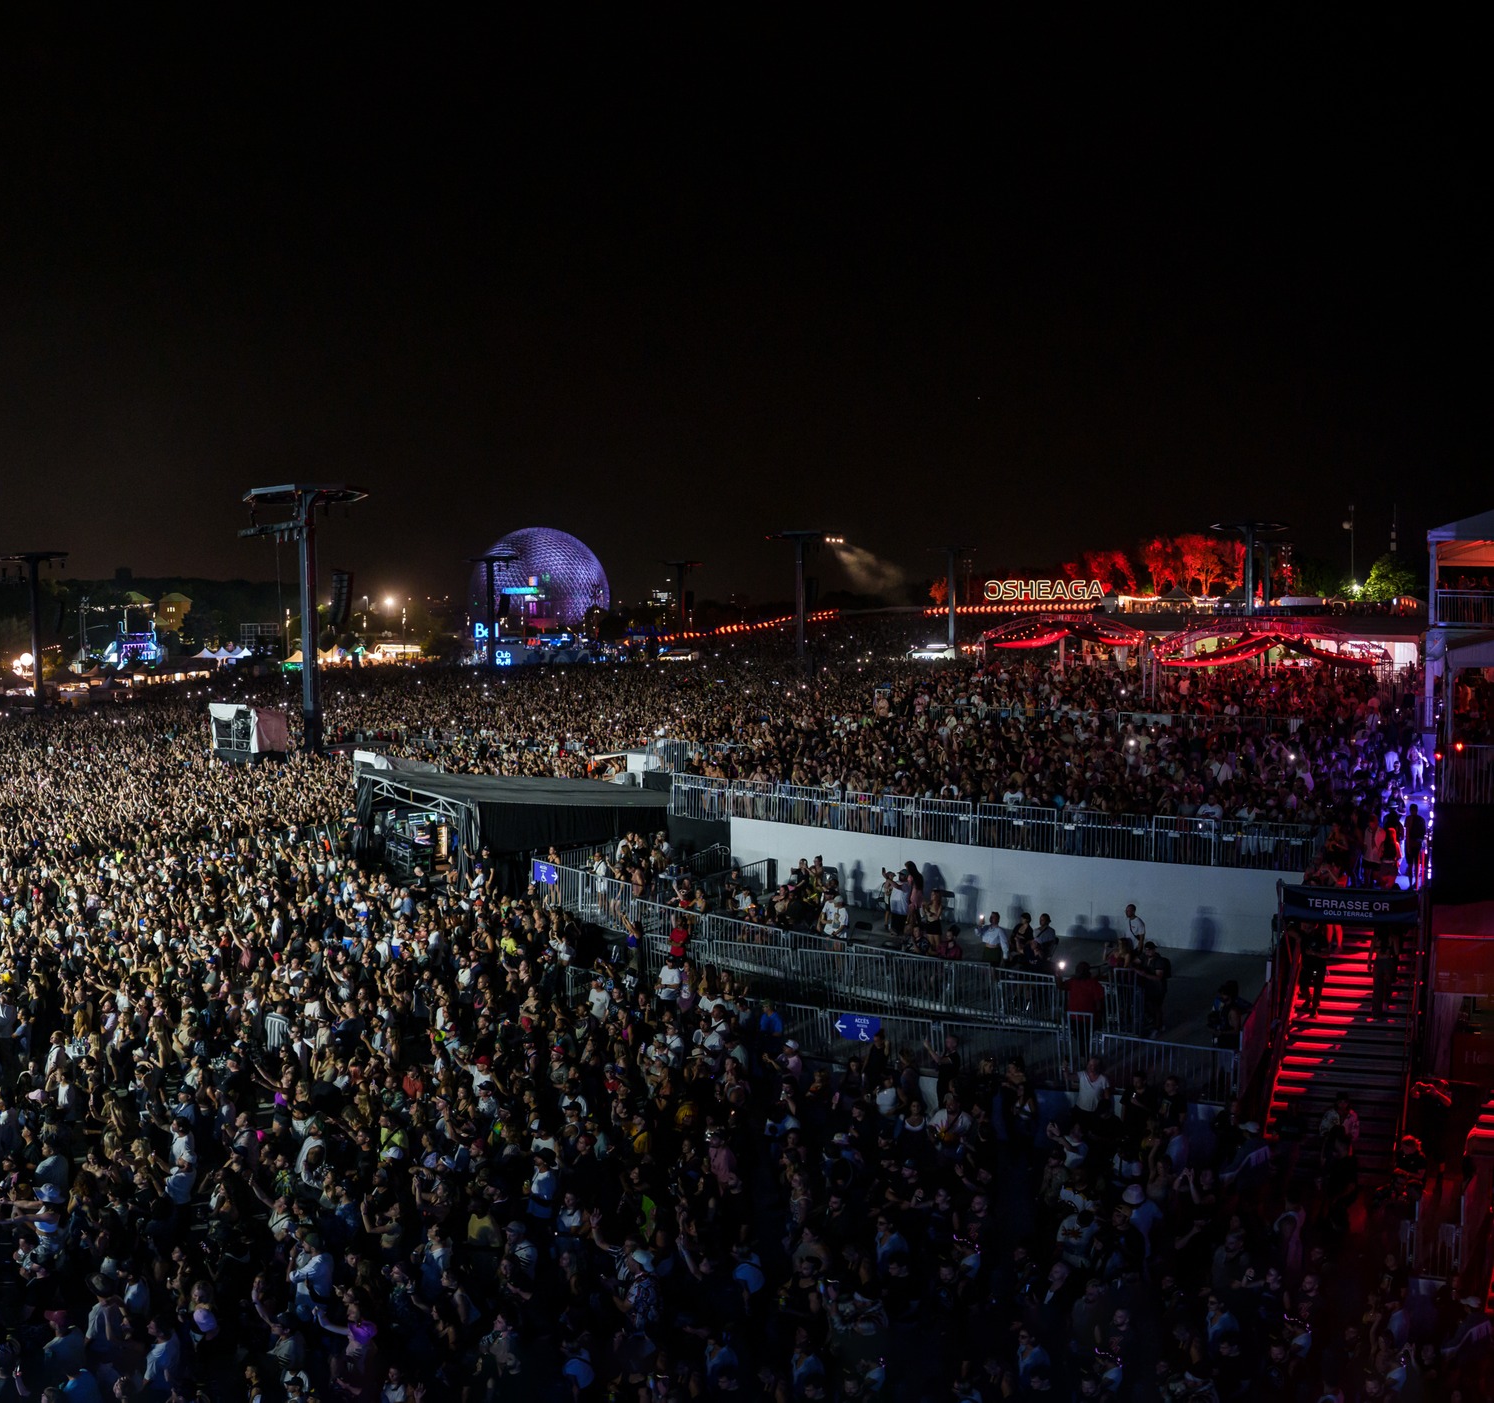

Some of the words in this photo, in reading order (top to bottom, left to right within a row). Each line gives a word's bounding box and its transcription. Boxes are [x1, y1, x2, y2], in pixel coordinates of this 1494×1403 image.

[983, 580, 1105, 600] OSHEAGA
[1308, 898, 1369, 910] TERRASSE
[1372, 902, 1390, 911] OR
